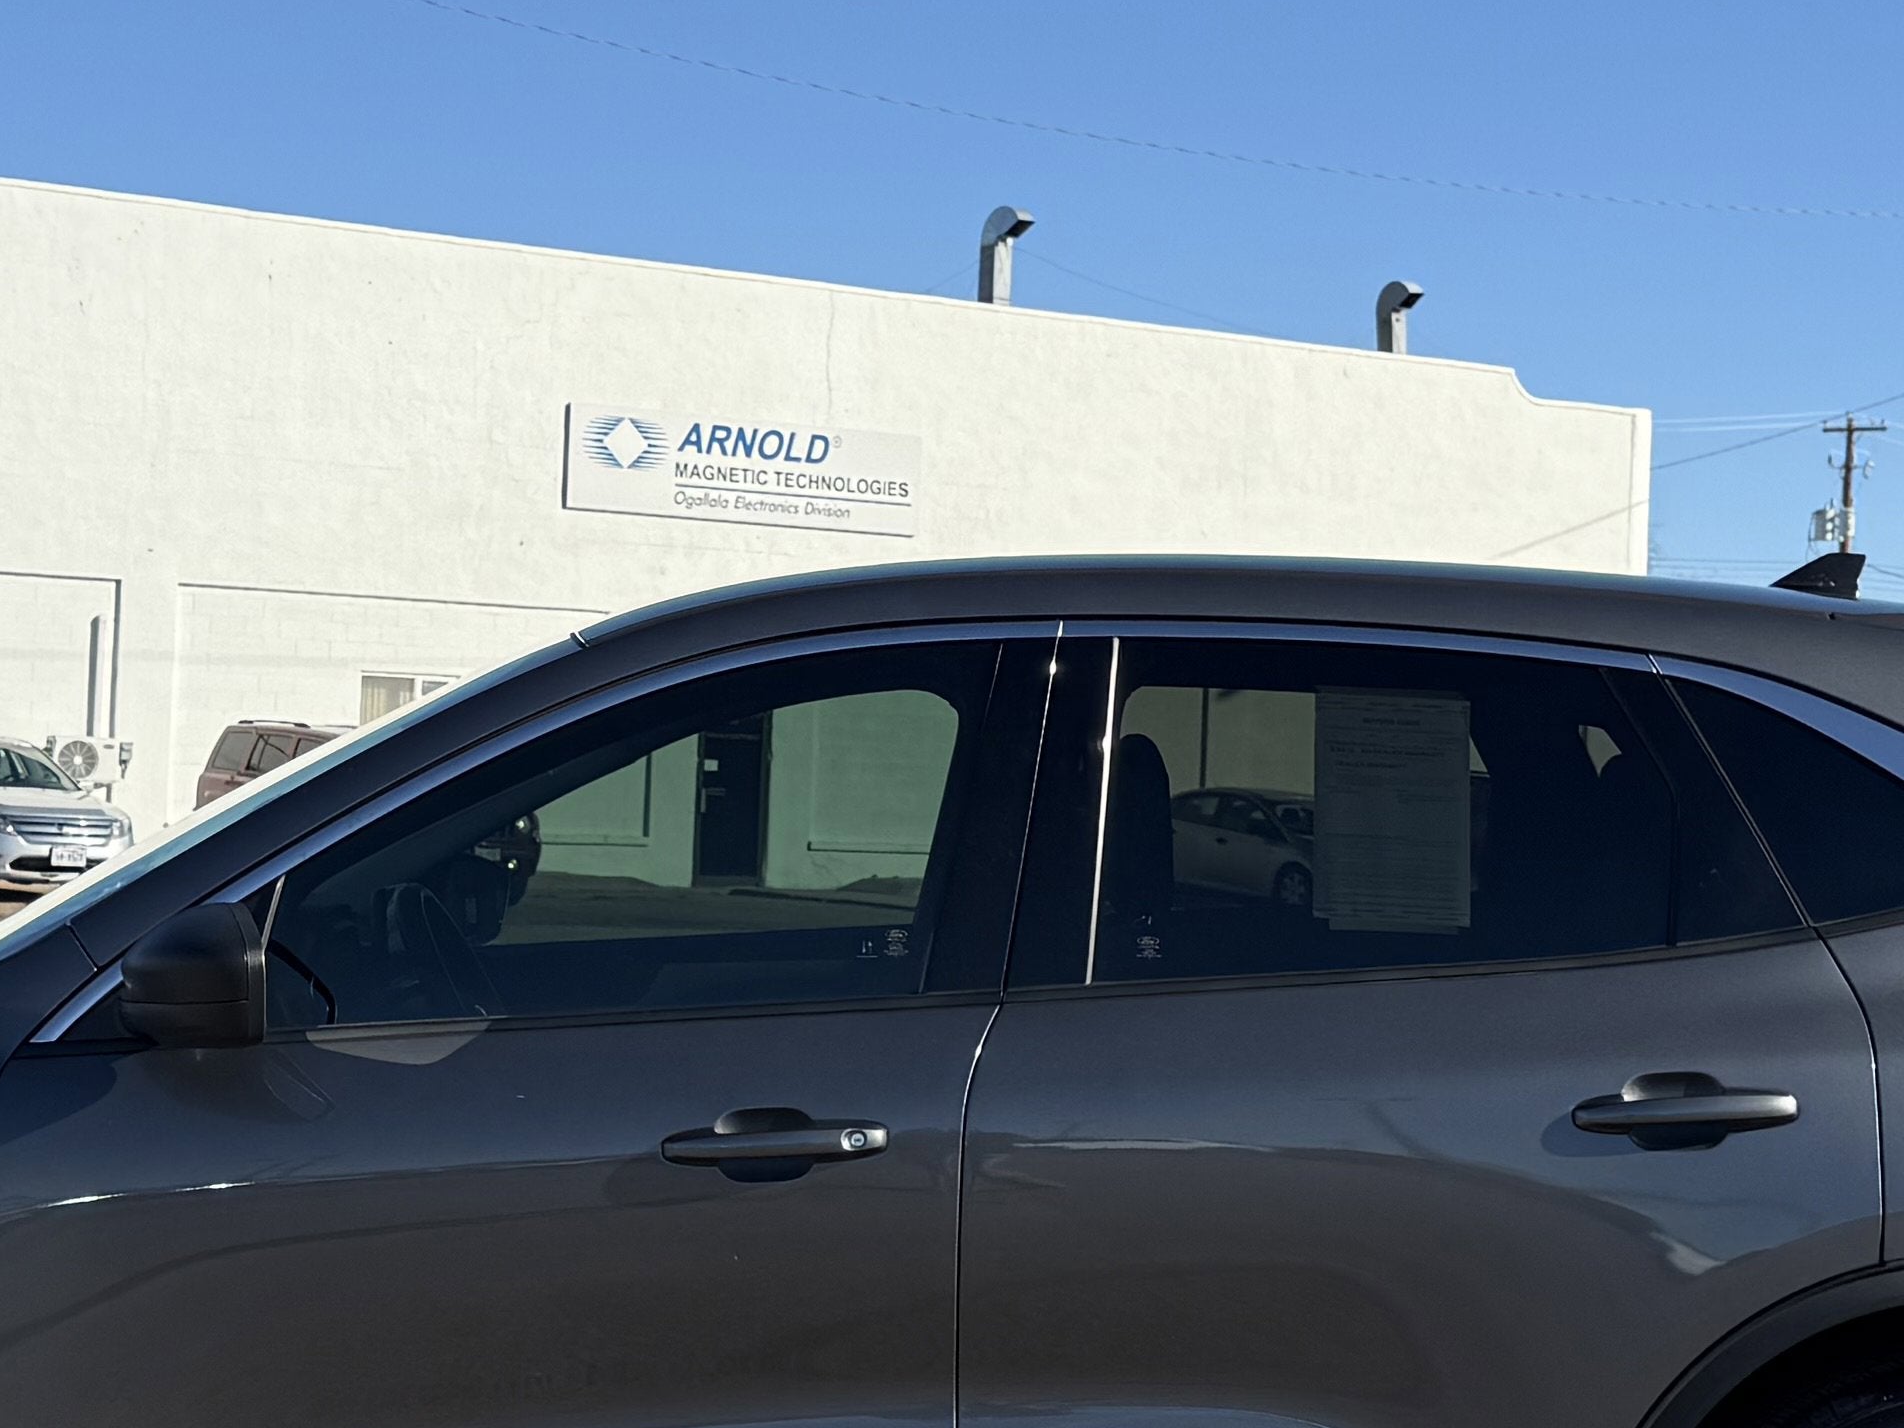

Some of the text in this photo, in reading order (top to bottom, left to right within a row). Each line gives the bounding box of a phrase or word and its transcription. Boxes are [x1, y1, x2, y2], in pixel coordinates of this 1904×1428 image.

[677, 422, 830, 464] ARNOLD
[674, 462, 909, 498] MAGNETIC TECHNOLOGIES
[673, 490, 851, 519] Ogallala Electronics Division
